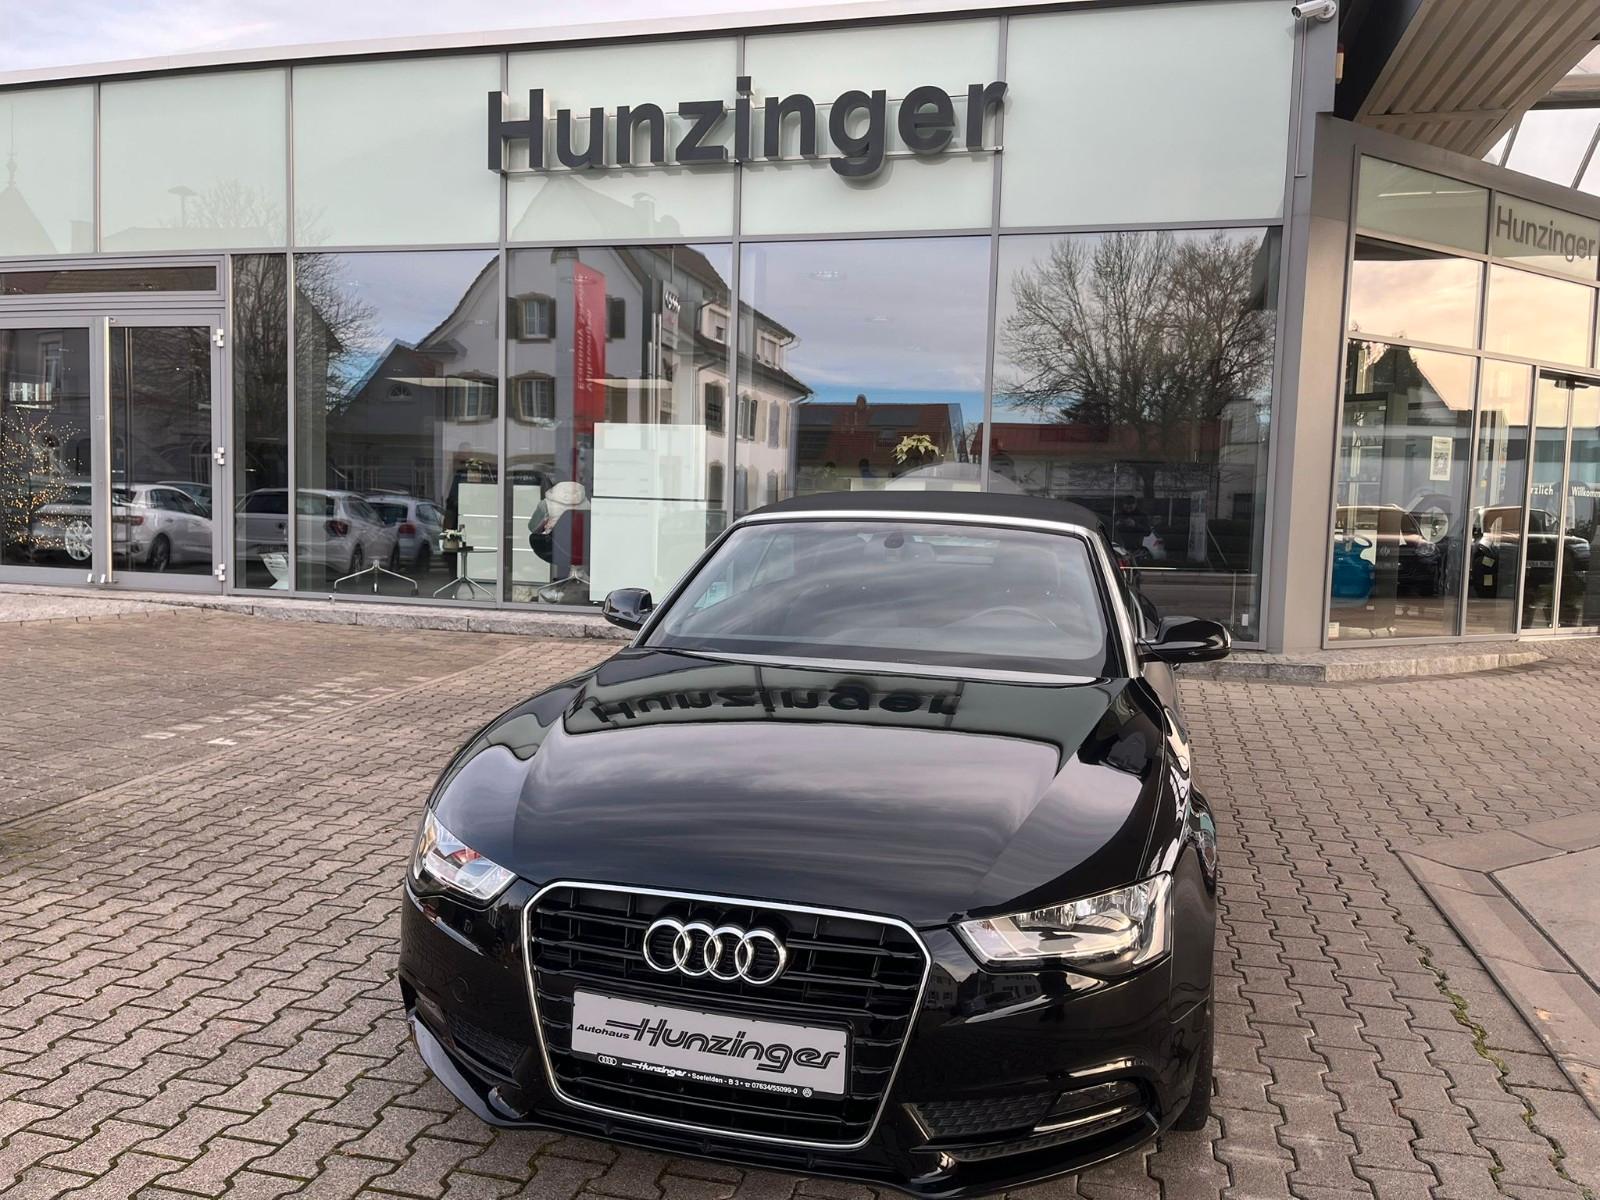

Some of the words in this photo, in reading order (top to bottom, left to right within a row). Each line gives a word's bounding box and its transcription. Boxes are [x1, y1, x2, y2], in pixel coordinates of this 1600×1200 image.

[487, 76, 1007, 178] Hunzinger
[1496, 205, 1596, 263] Hunzinger
[1530, 484, 1553, 496] rzlich
[576, 1023, 630, 1040] Autohaus
[606, 1018, 841, 1074] Hunzinger
[622, 1061, 687, 1077] Hunzinger
[692, 1072, 723, 1084] Seefelden
